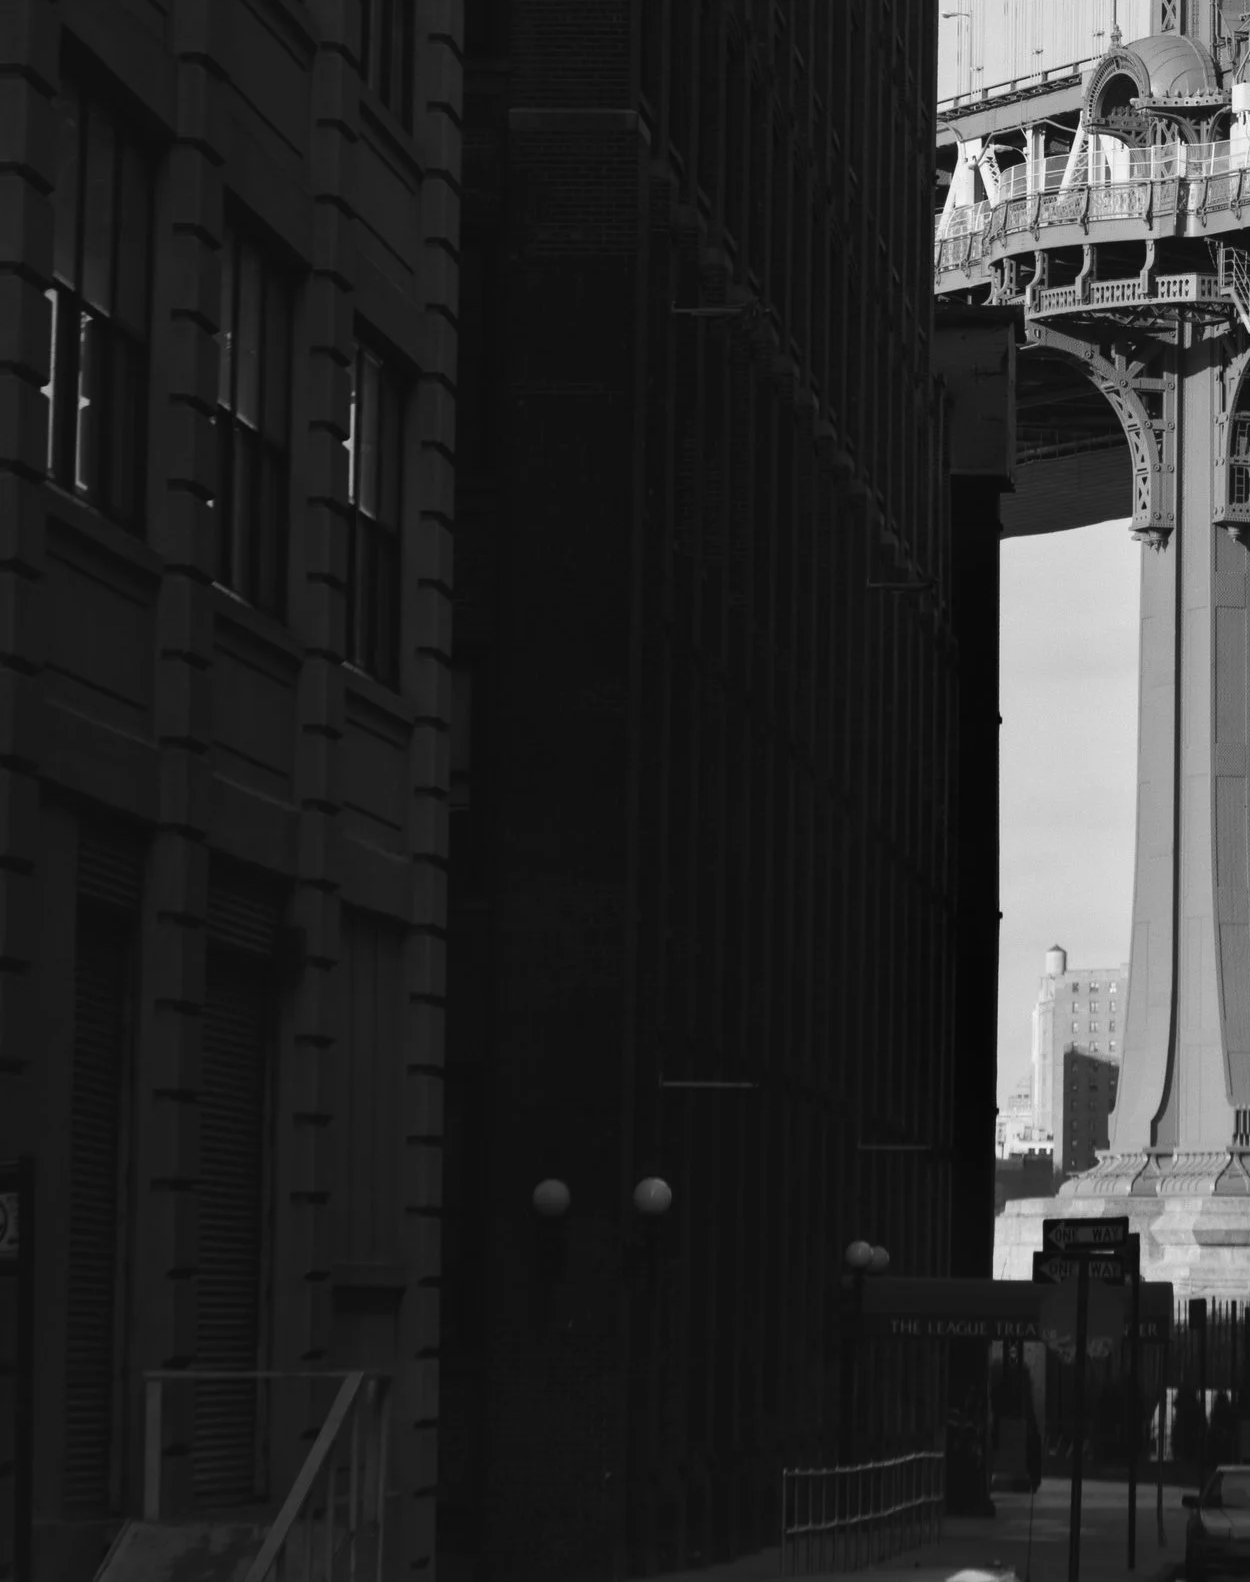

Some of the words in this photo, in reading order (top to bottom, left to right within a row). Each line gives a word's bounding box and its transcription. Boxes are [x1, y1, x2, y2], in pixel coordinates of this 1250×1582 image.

[1054, 1226, 1077, 1242] ONE
[1092, 1225, 1118, 1242] WAY
[1048, 1260, 1073, 1275] ONE
[1090, 1261, 1118, 1276] WAY
[891, 1319, 921, 1335] THE
[928, 1320, 988, 1335] LEAGUE
